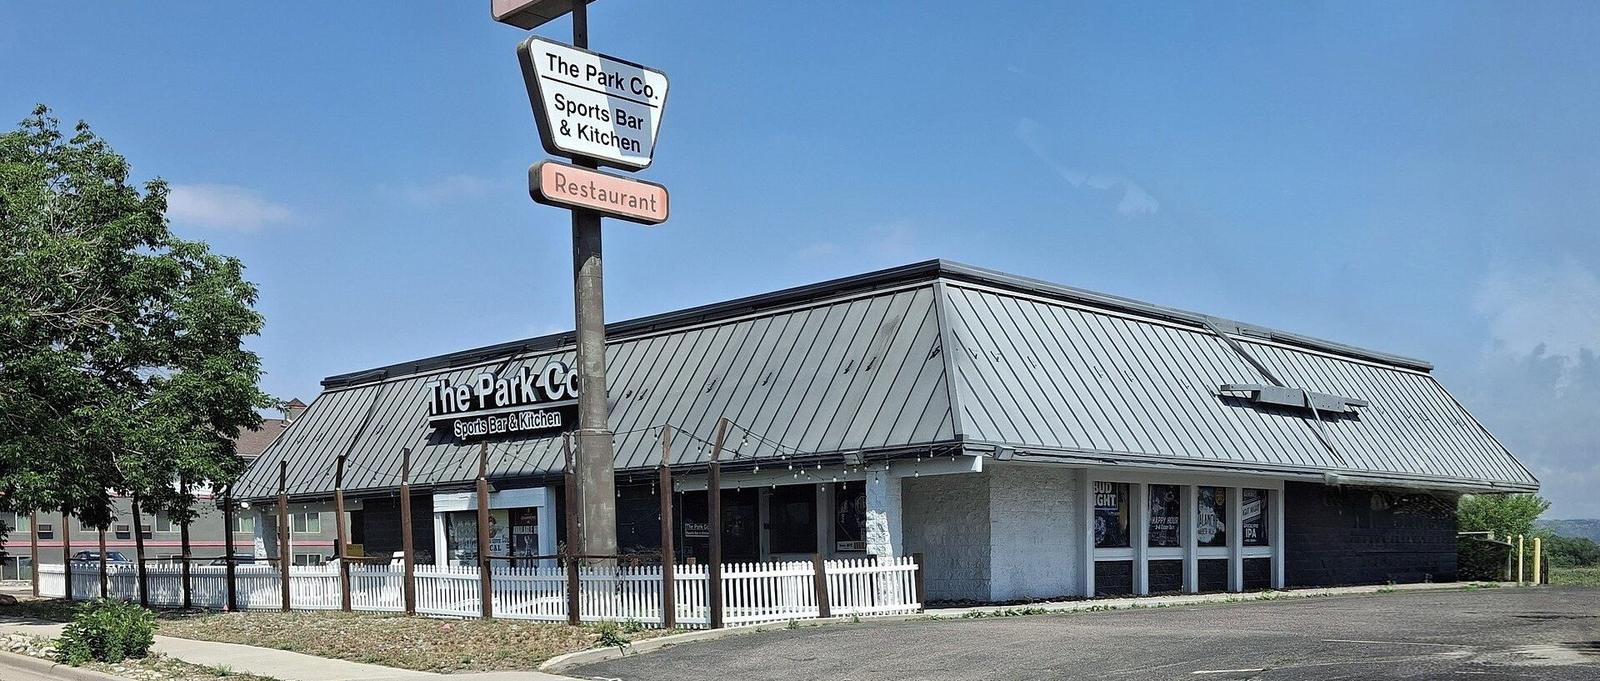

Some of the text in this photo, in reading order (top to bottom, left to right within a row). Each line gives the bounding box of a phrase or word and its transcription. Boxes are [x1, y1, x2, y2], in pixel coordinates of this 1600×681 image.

[546, 53, 659, 99] The Park Co.
[554, 93, 644, 130] Sports Bar
[559, 120, 641, 153] & Kitchen
[555, 172, 657, 212] Restaurant
[429, 379, 471, 414] The
[477, 366, 538, 409] Park
[453, 410, 562, 440] Sports Bar & Kitchen
[1094, 482, 1112, 494] BUD
[1095, 494, 1116, 506] IGHT
[1245, 528, 1256, 538] IPA
